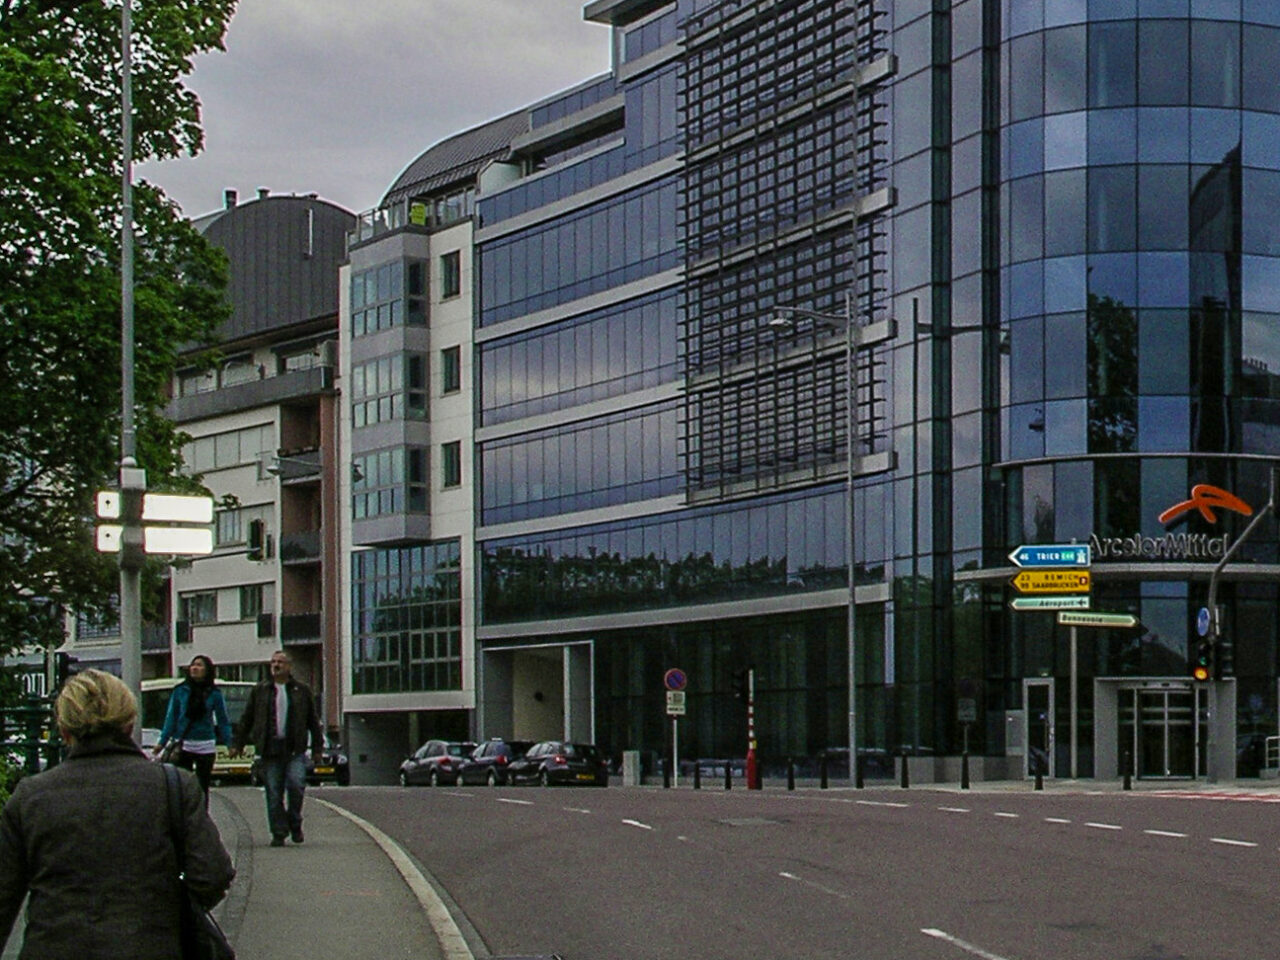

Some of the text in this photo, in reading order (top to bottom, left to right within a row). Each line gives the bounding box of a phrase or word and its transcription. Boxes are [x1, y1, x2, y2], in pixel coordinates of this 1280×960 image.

[1089, 532, 1229, 557] ArcelorMittal
[1036, 552, 1060, 561] TRIER
[1044, 573, 1080, 582] REMICH
